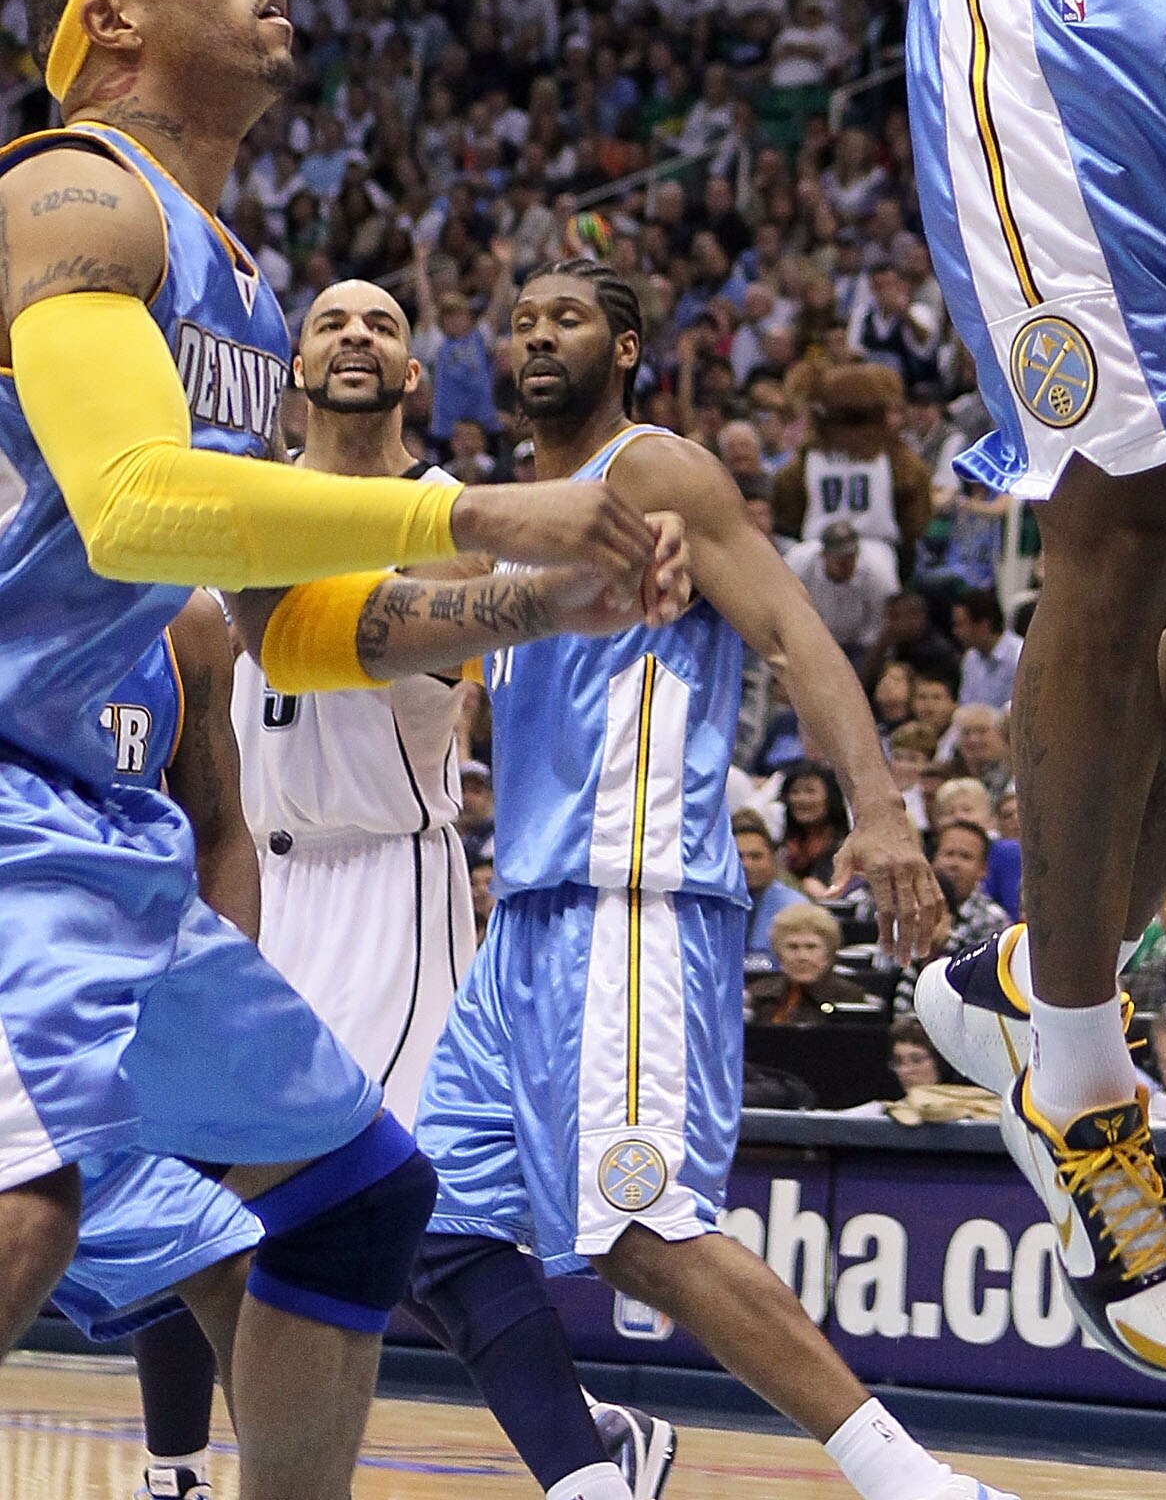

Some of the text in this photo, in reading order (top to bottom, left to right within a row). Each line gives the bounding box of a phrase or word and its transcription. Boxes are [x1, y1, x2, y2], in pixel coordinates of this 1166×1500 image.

[176, 319, 289, 441] DENVE
[100, 703, 153, 776] R
[717, 1178, 1107, 1350] ba.co
